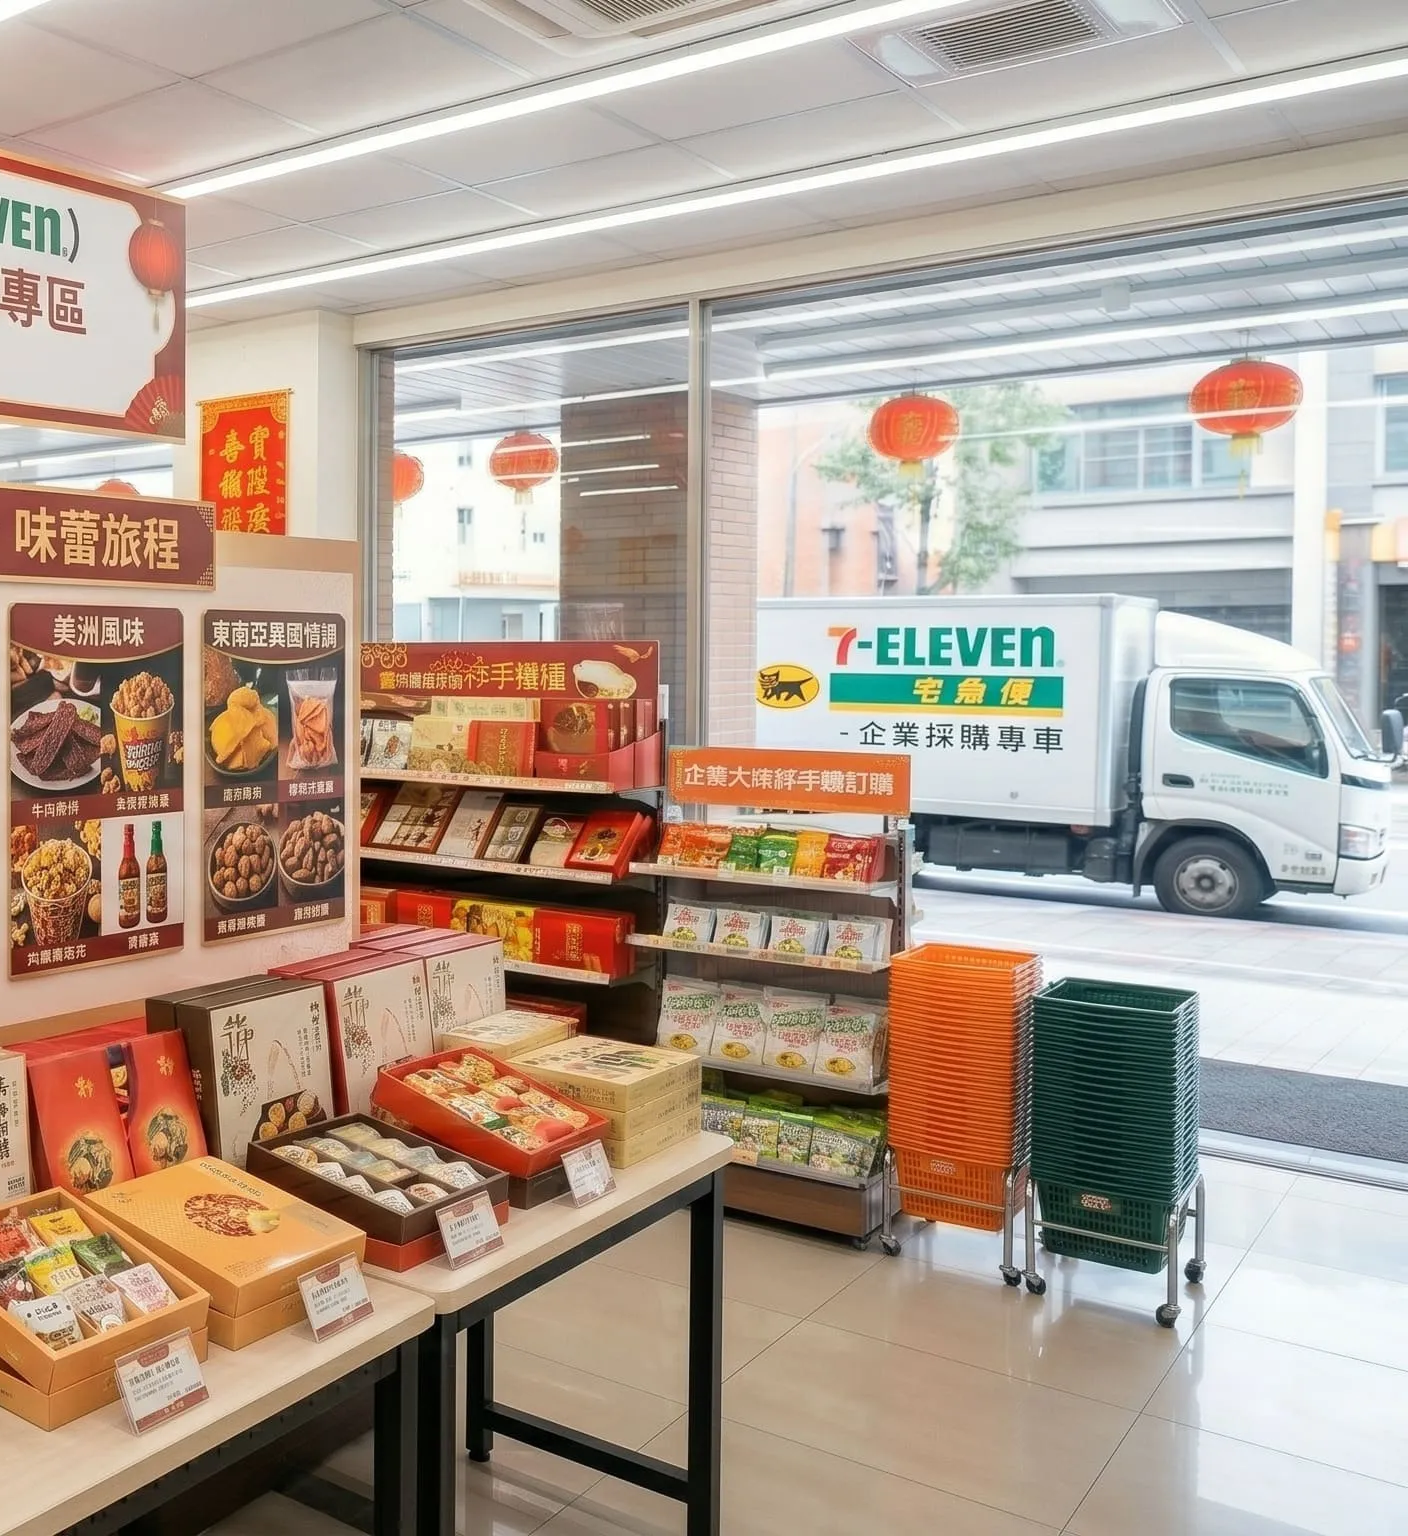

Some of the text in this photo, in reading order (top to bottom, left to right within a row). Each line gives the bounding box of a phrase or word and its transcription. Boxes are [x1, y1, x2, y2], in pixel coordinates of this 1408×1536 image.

[52, 614, 145, 648] 美洲風味
[211, 619, 337, 649] 東南亞異國情調
[912, 676, 1035, 706] 宅急便
[858, 720, 1064, 755] 企業採購專車
